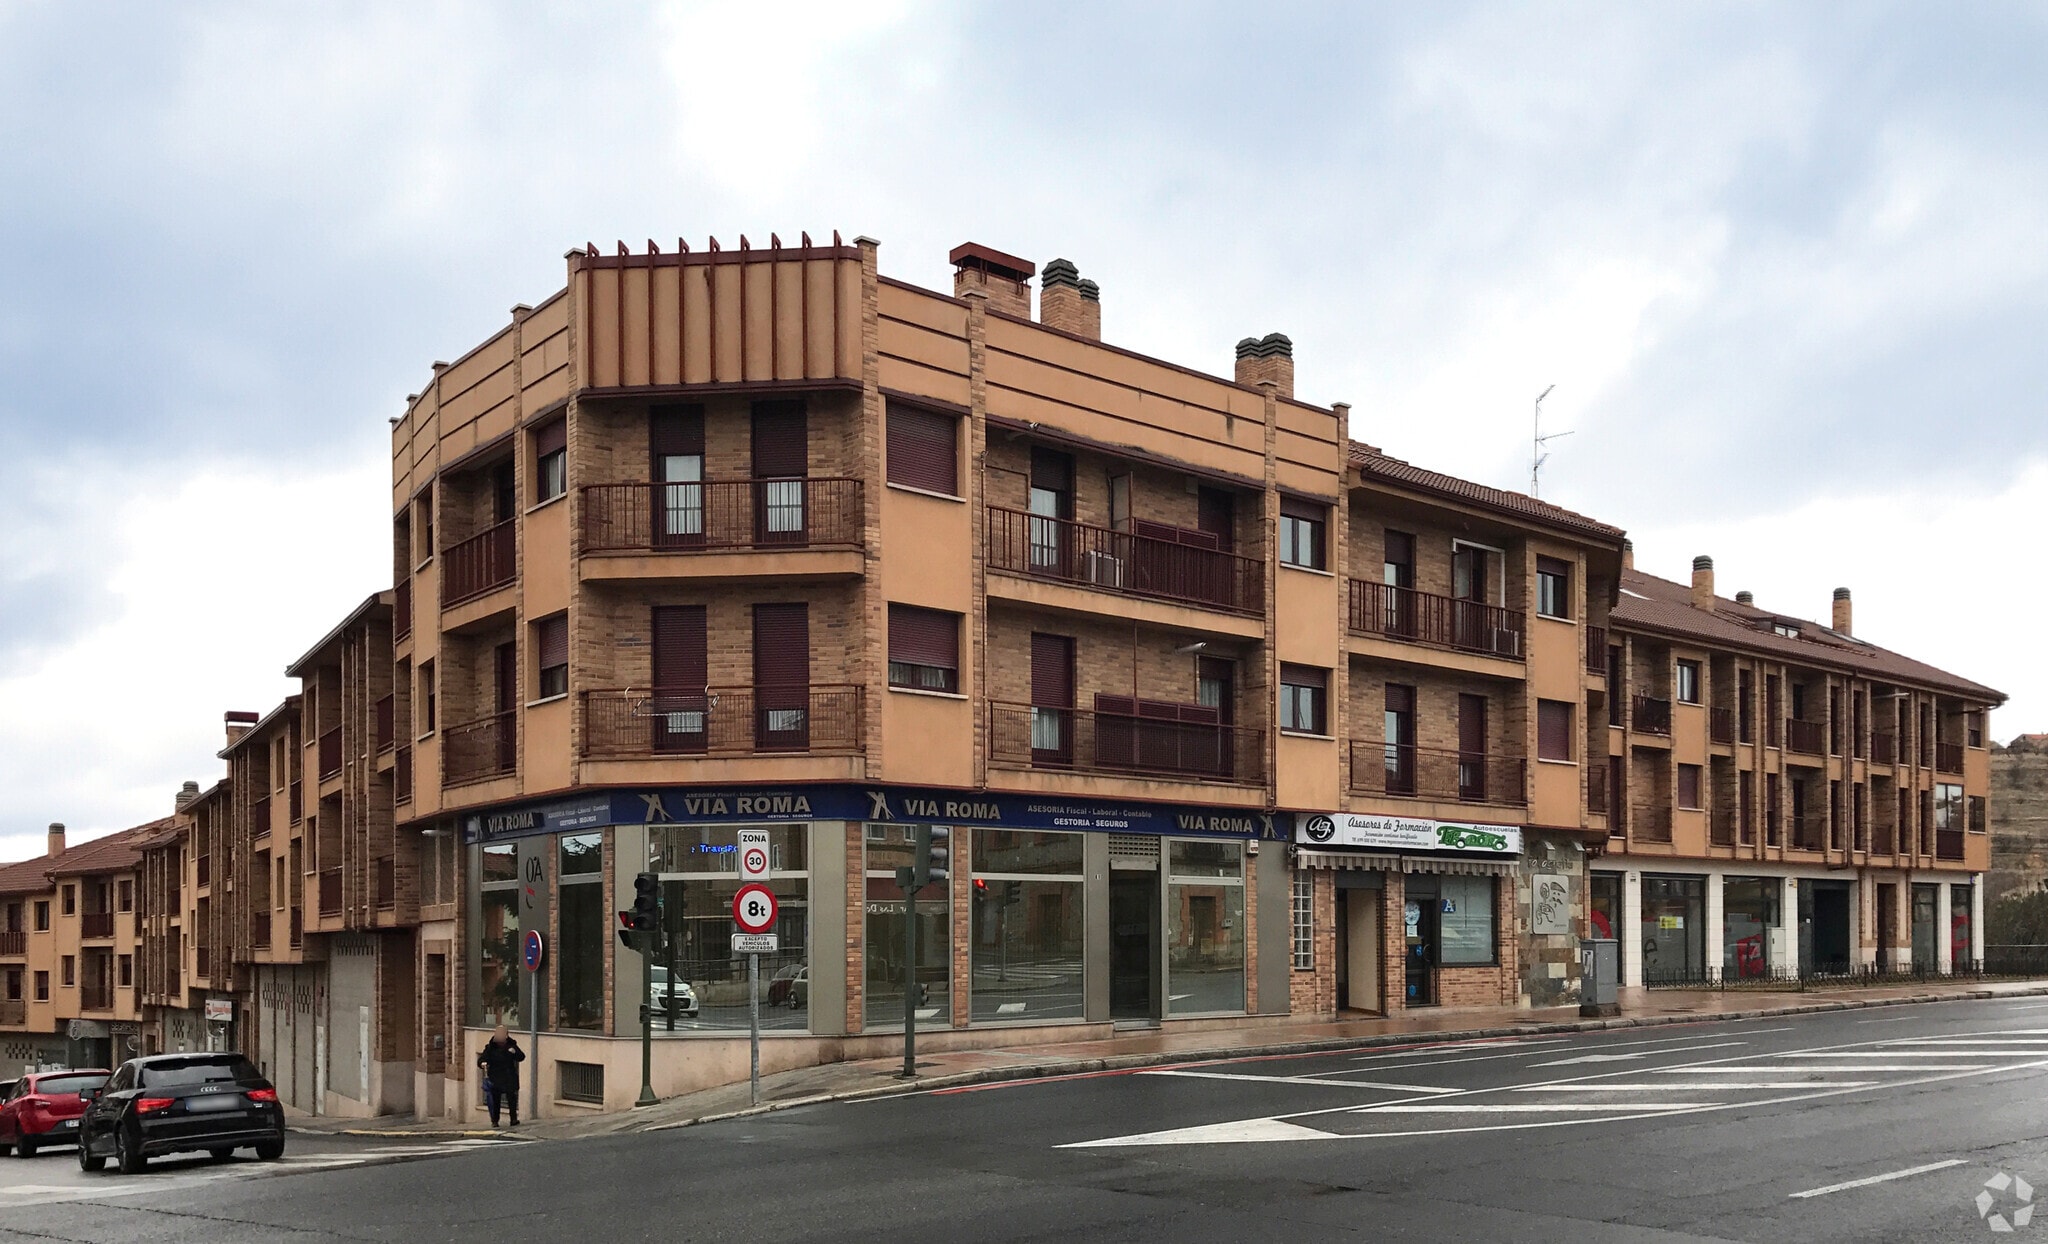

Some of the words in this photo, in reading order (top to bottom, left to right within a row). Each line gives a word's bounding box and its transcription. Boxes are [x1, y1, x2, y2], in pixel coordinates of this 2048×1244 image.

[684, 797, 728, 815] VIA
[737, 796, 811, 814] ROMA
[904, 798, 939, 816] VIA
[946, 801, 1001, 820] ROMA
[1027, 804, 1065, 814] ASESORIA
[1066, 806, 1087, 815] Fiscal
[1092, 808, 1118, 817] Laboral
[1122, 809, 1152, 818] Contable
[488, 816, 505, 833] VIA
[506, 812, 535, 831] ROMA
[1053, 817, 1090, 827] GESTORIA
[1095, 819, 1129, 828] SEGUROS
[1179, 814, 1205, 830] VIA
[1210, 816, 1254, 833] ROMA
[1347, 816, 1381, 829] Asesores
[1383, 819, 1392, 830] de
[1393, 820, 1432, 833] Formación
[1473, 825, 1518, 833] Autoescuelas
[742, 834, 767, 843] ZONA
[749, 856, 762, 866] 30
[748, 900, 766, 917] 8t
